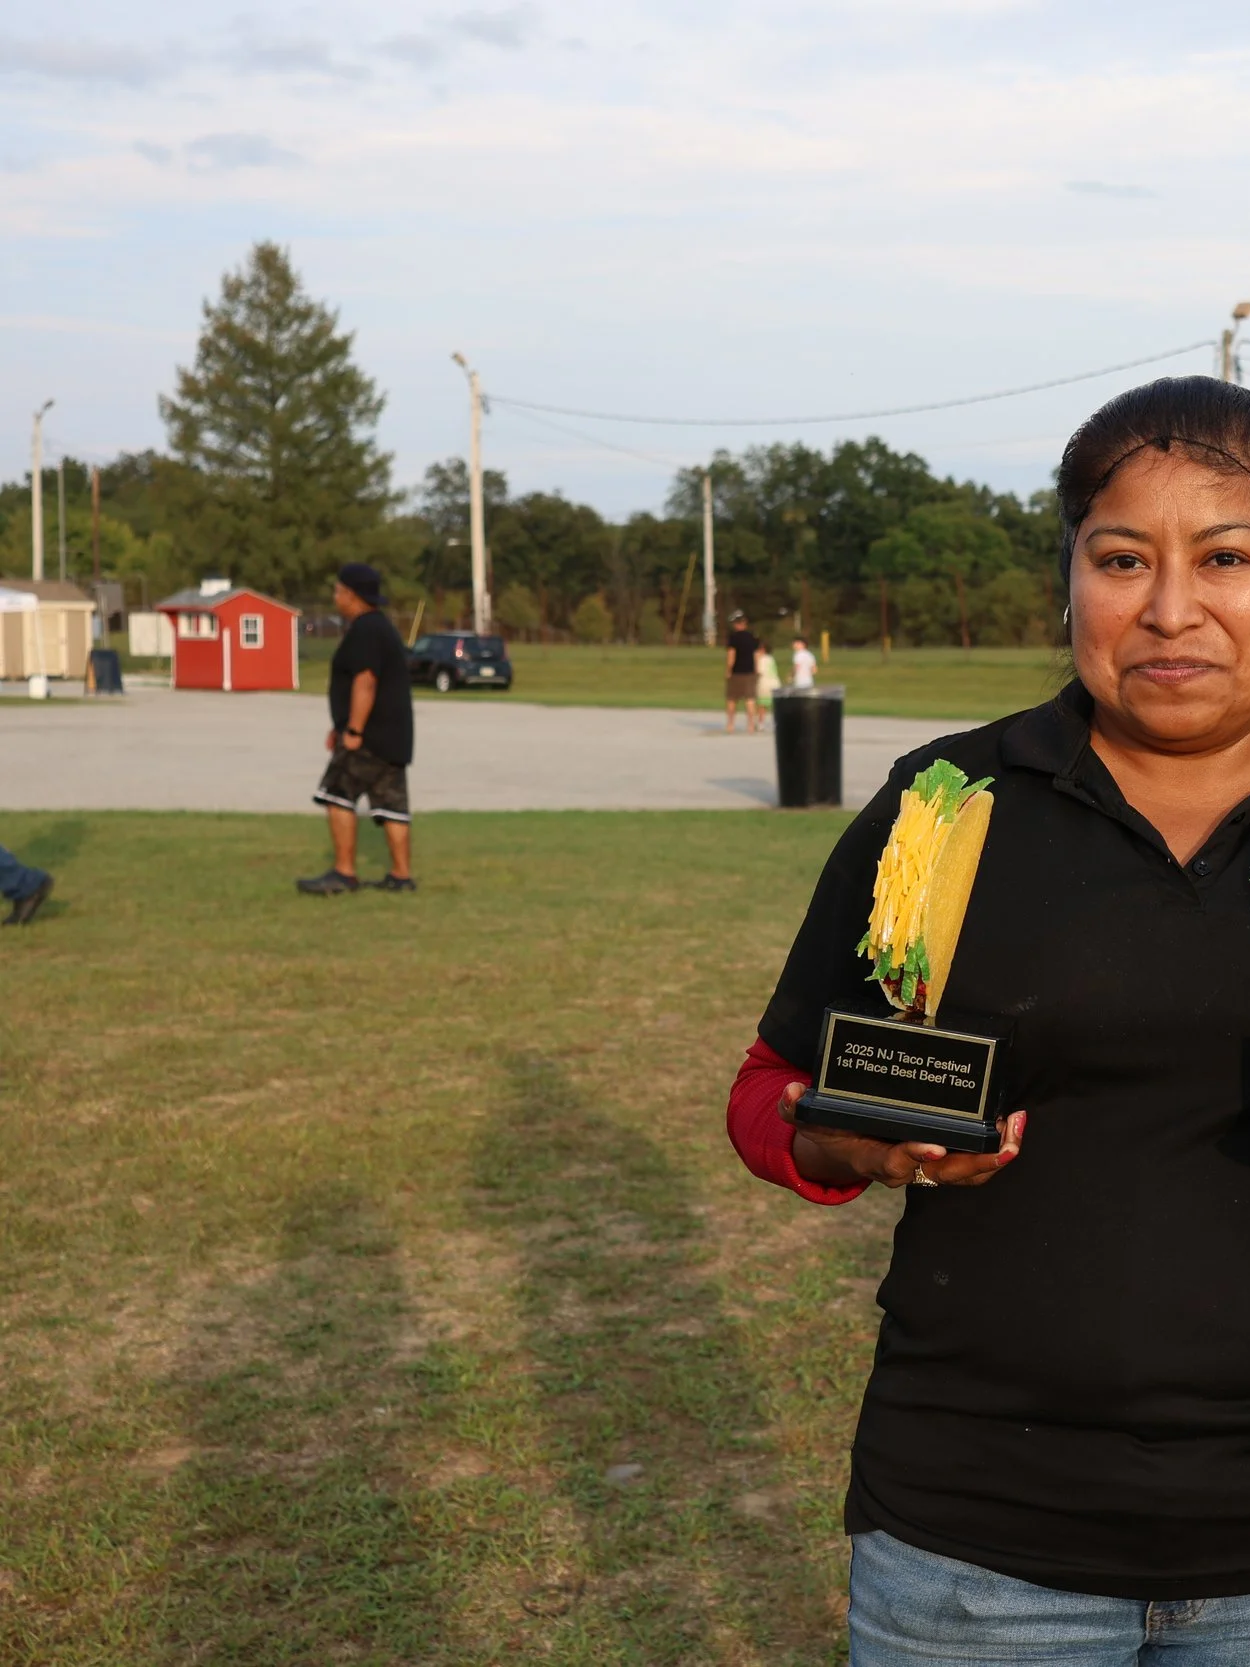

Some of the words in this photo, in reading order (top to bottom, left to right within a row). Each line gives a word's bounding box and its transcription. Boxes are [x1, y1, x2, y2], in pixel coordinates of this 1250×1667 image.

[836, 1056, 853, 1069] 1st
[855, 1058, 888, 1074] Place
[890, 1065, 916, 1080] Best
[919, 1070, 947, 1084] Beef
[949, 1075, 976, 1089] Taco
[844, 1042, 874, 1057] 2025
[877, 1048, 894, 1061] NJ
[897, 1051, 924, 1066] Taco
[926, 1056, 971, 1074] Festival
